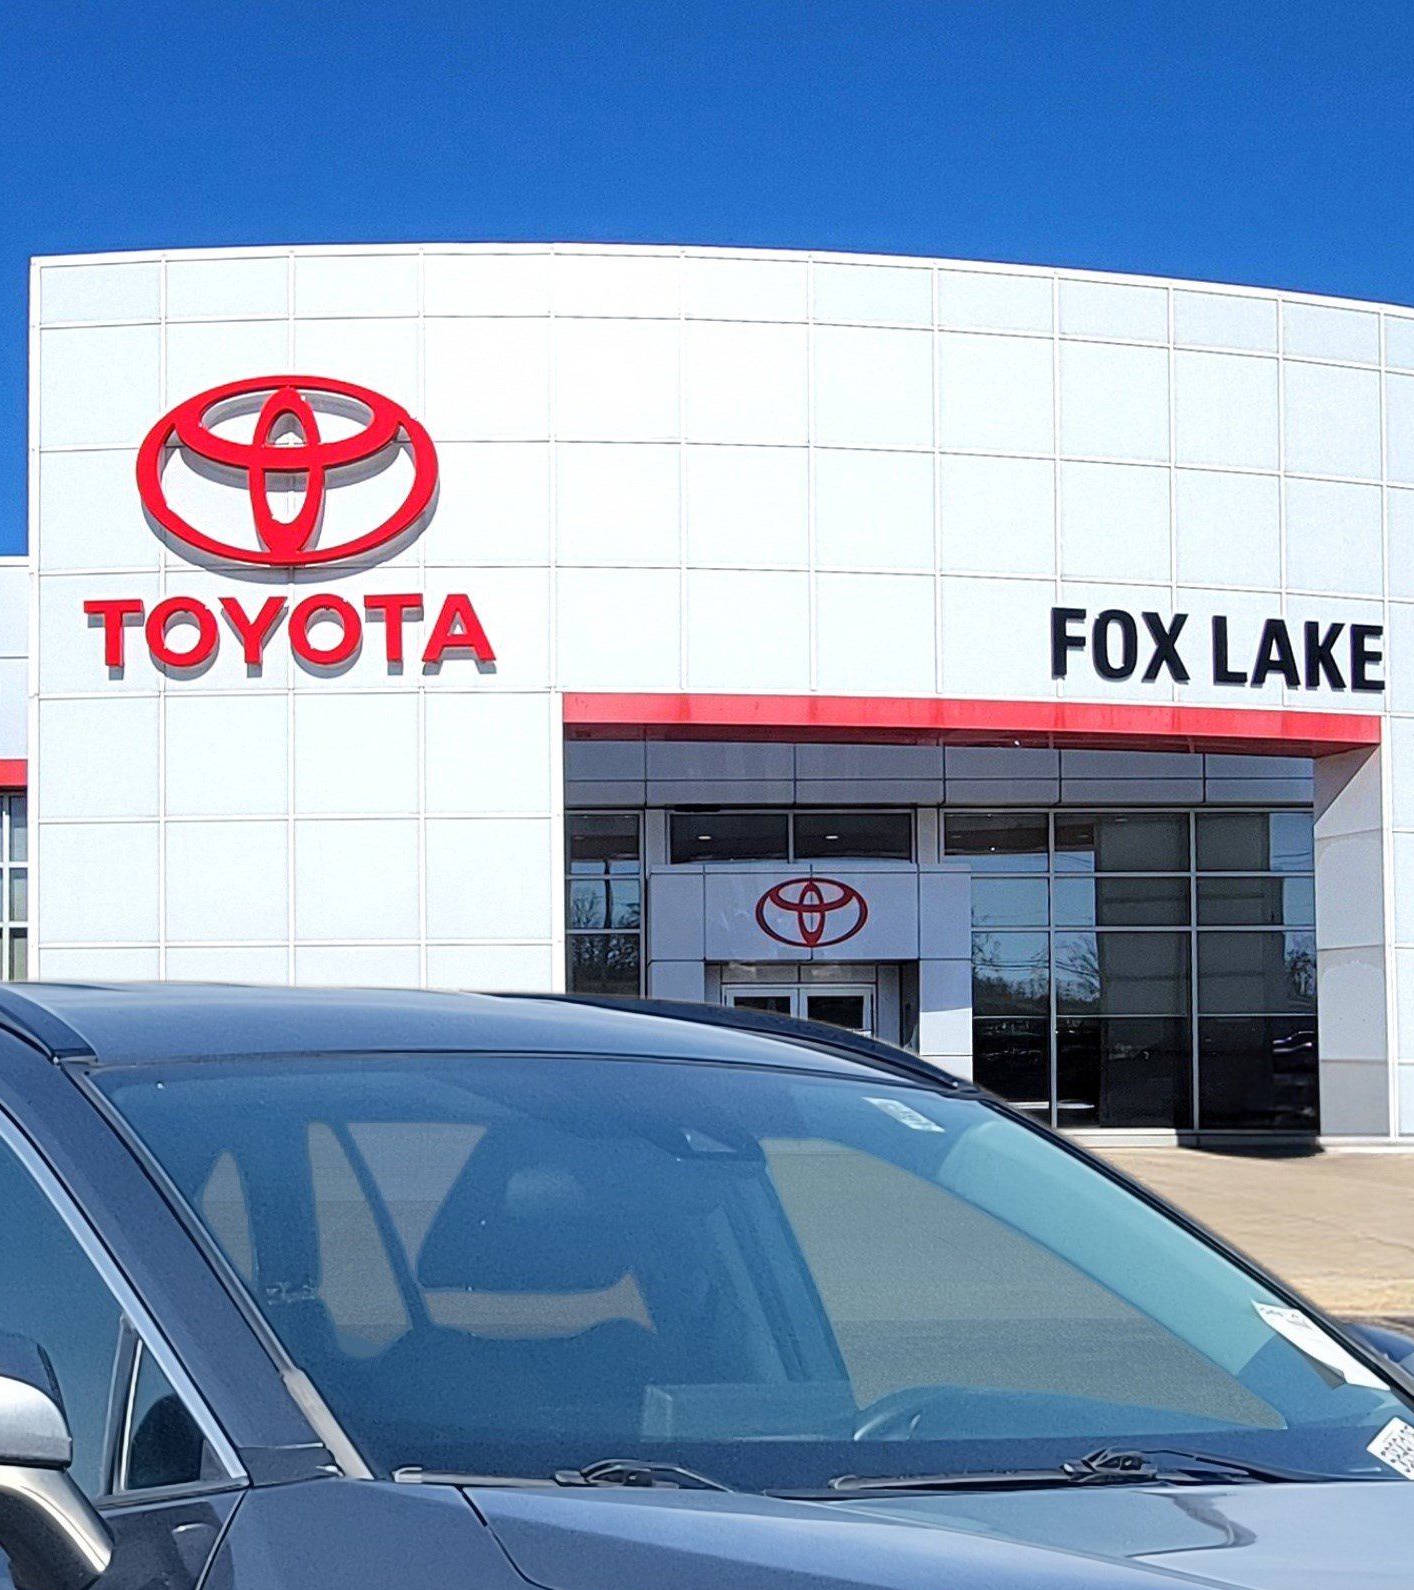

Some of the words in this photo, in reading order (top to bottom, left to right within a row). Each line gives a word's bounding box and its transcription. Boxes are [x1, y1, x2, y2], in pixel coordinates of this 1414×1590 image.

[83, 593, 497, 668] TOYOTA
[1051, 606, 1190, 681] FOX
[1211, 615, 1386, 690] LAKE
